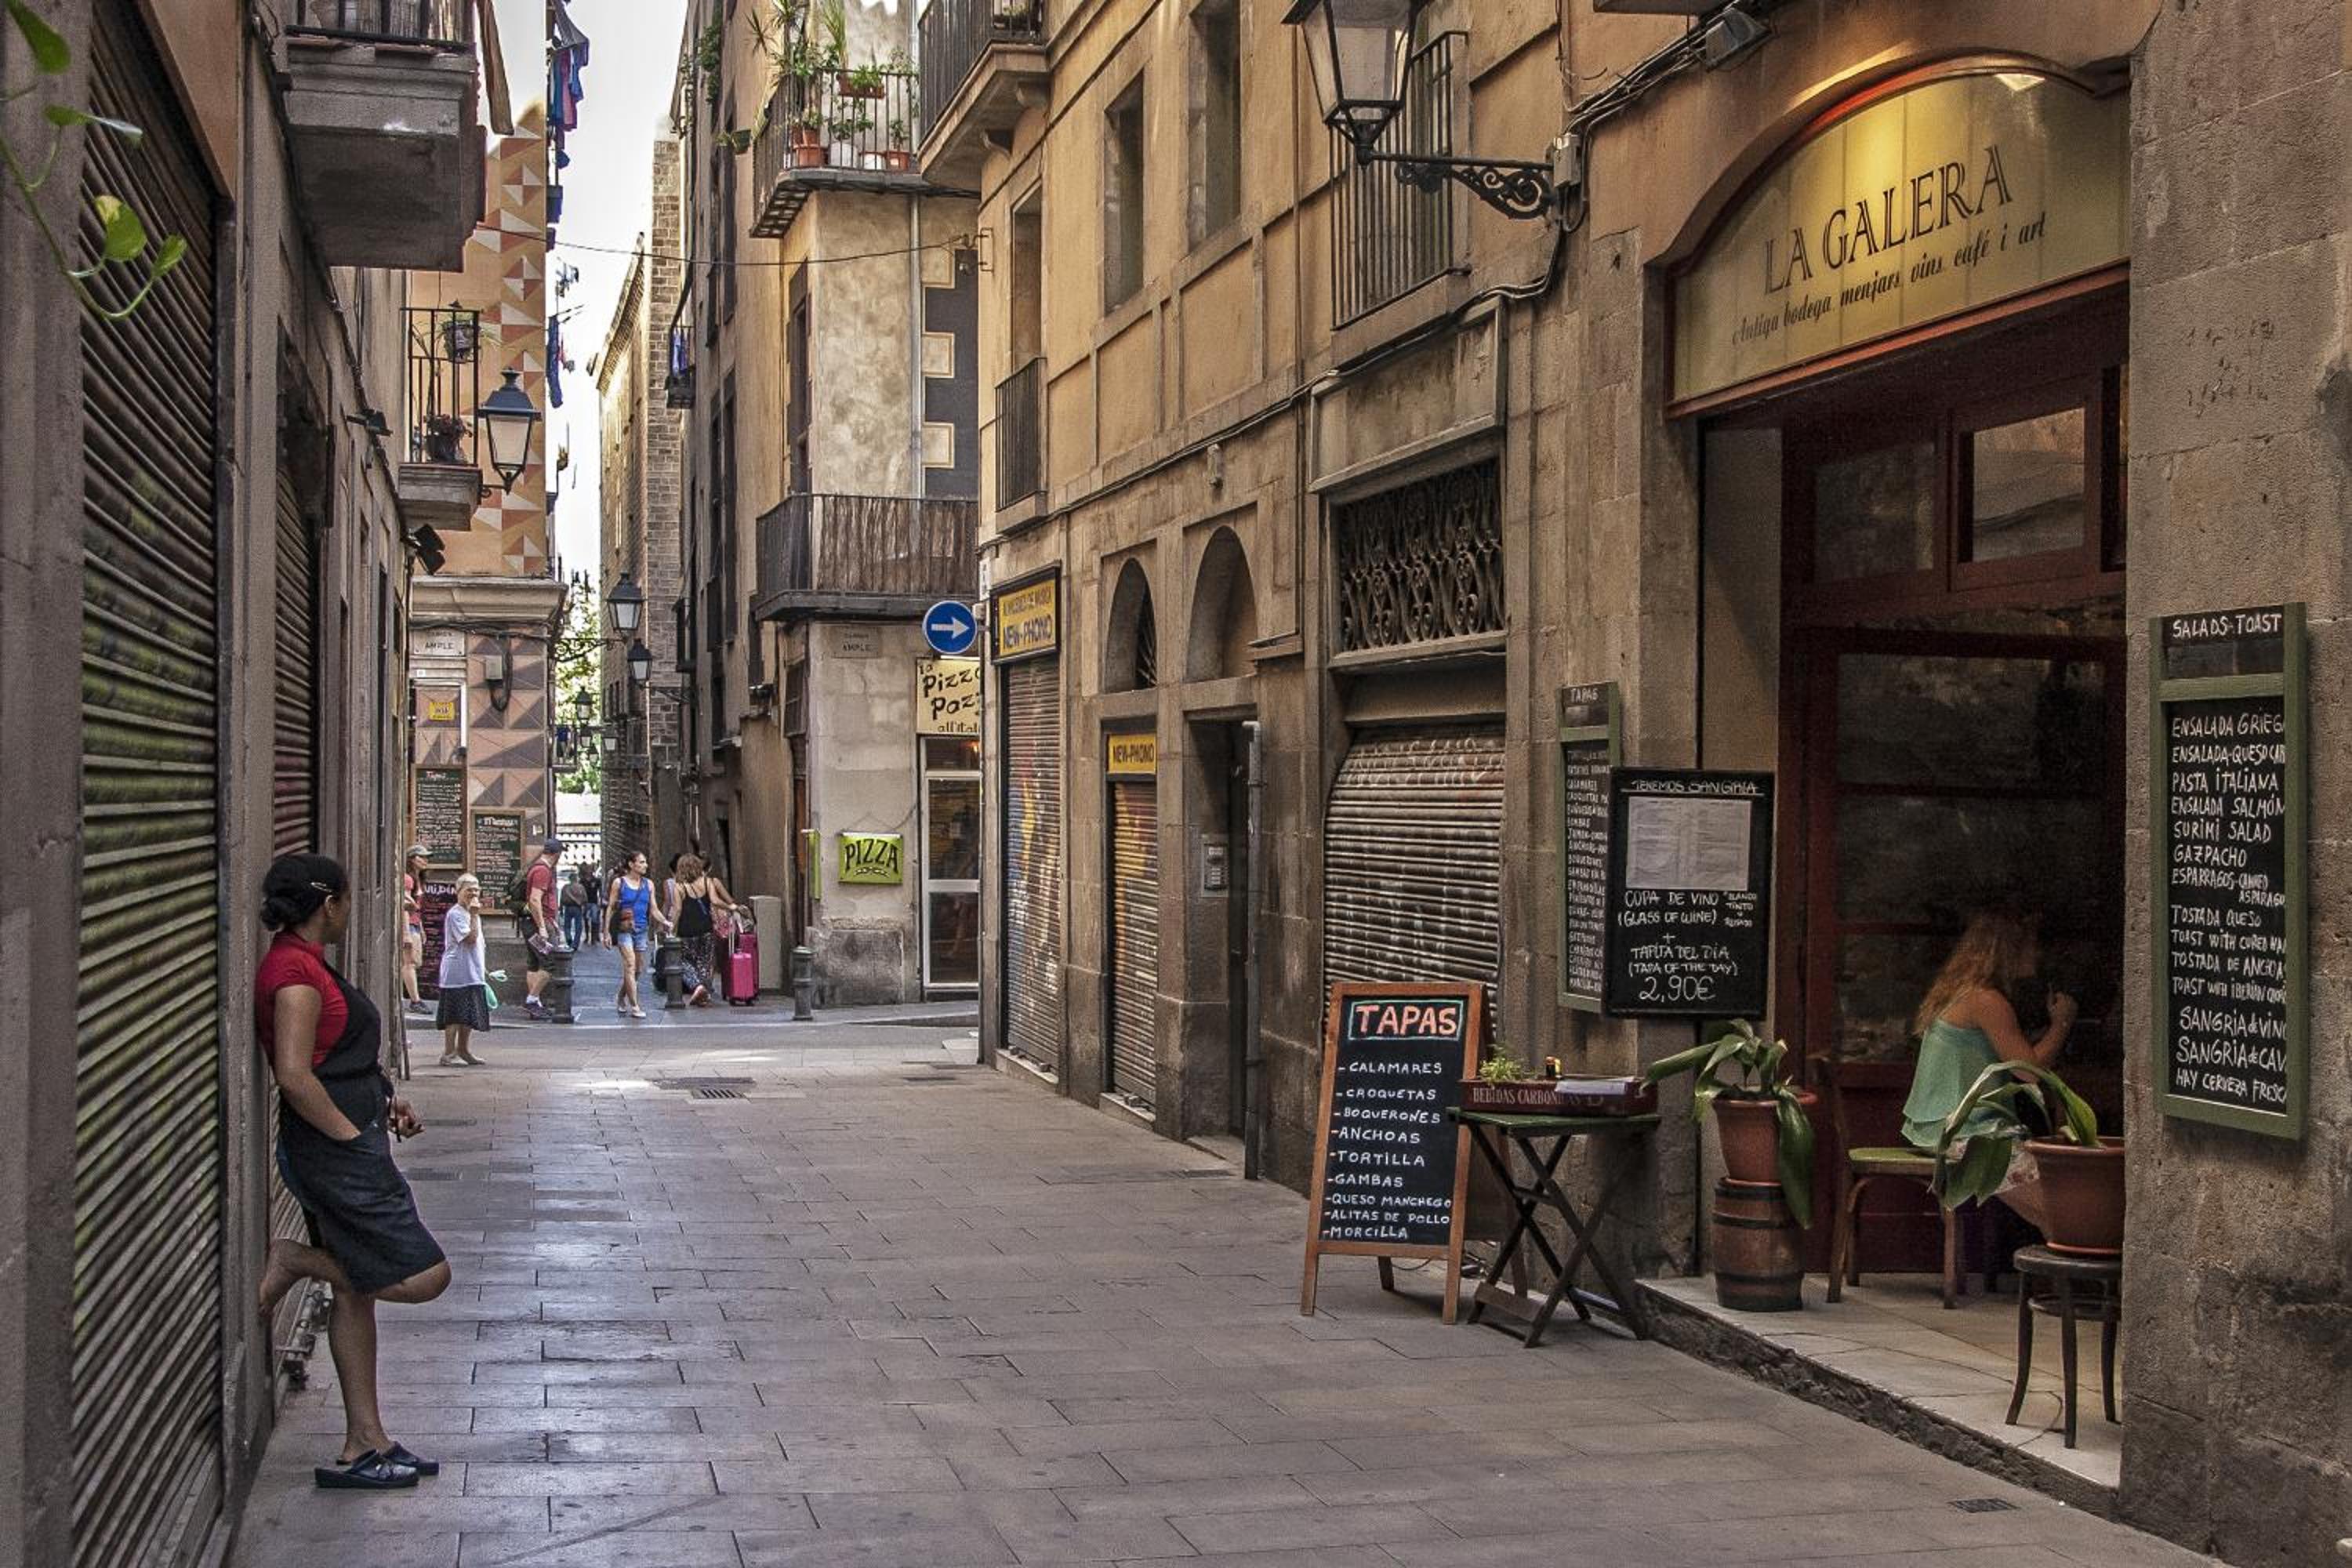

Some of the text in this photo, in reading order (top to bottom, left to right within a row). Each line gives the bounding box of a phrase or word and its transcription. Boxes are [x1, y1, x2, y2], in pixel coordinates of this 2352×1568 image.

[1765, 144, 2013, 295] LA GALERA
[1953, 229, 1991, 267] café
[2001, 223, 2009, 251] i
[2019, 211, 2046, 245] art
[426, 641, 455, 650] AMPLE
[931, 692, 979, 720] Paz
[2171, 706, 2285, 739] ENSALADA GRIEG
[2172, 771, 2209, 793] PASTA
[2171, 795, 2223, 817] ENSALADA
[2173, 818, 2272, 844] SURIMI SALAD
[845, 838, 898, 875] PIZZA
[2173, 844, 2248, 868] GAZPACHO
[1624, 890, 1661, 907] COPA
[1668, 891, 1686, 906] DE
[1690, 891, 1719, 906] VINO
[1664, 912, 1679, 924] OF
[2171, 904, 2263, 927] TOSTADA QUESO
[2171, 929, 2205, 946] TOAST
[1675, 944, 1700, 960] DEL
[1664, 963, 1679, 974] OF
[1681, 963, 1707, 972] THE
[2171, 951, 2221, 974] TOSTADA
[2227, 957, 2240, 971] DE
[1639, 975, 1717, 1004] 2,90€
[2172, 977, 2205, 996] TOAST
[1356, 1004, 1457, 1035] TAPAS
[1348, 1061, 1443, 1075] CALAMARES
[2176, 1067, 2198, 1090] HAY
[2202, 1073, 2248, 1097] CERVEZA
[1345, 1088, 1437, 1101] CROQUETAS
[1343, 1106, 1441, 1124] BOQUERONES
[1338, 1126, 1421, 1144] ANCHOAS
[1338, 1149, 1425, 1167] TORTILLA
[1334, 1173, 1403, 1188] GAMBAS
[1332, 1193, 1452, 1208] QUESO MANCHEGO
[1330, 1209, 1450, 1225] ALITAS DE POLLO
[1330, 1225, 1409, 1240] MORCILLA
